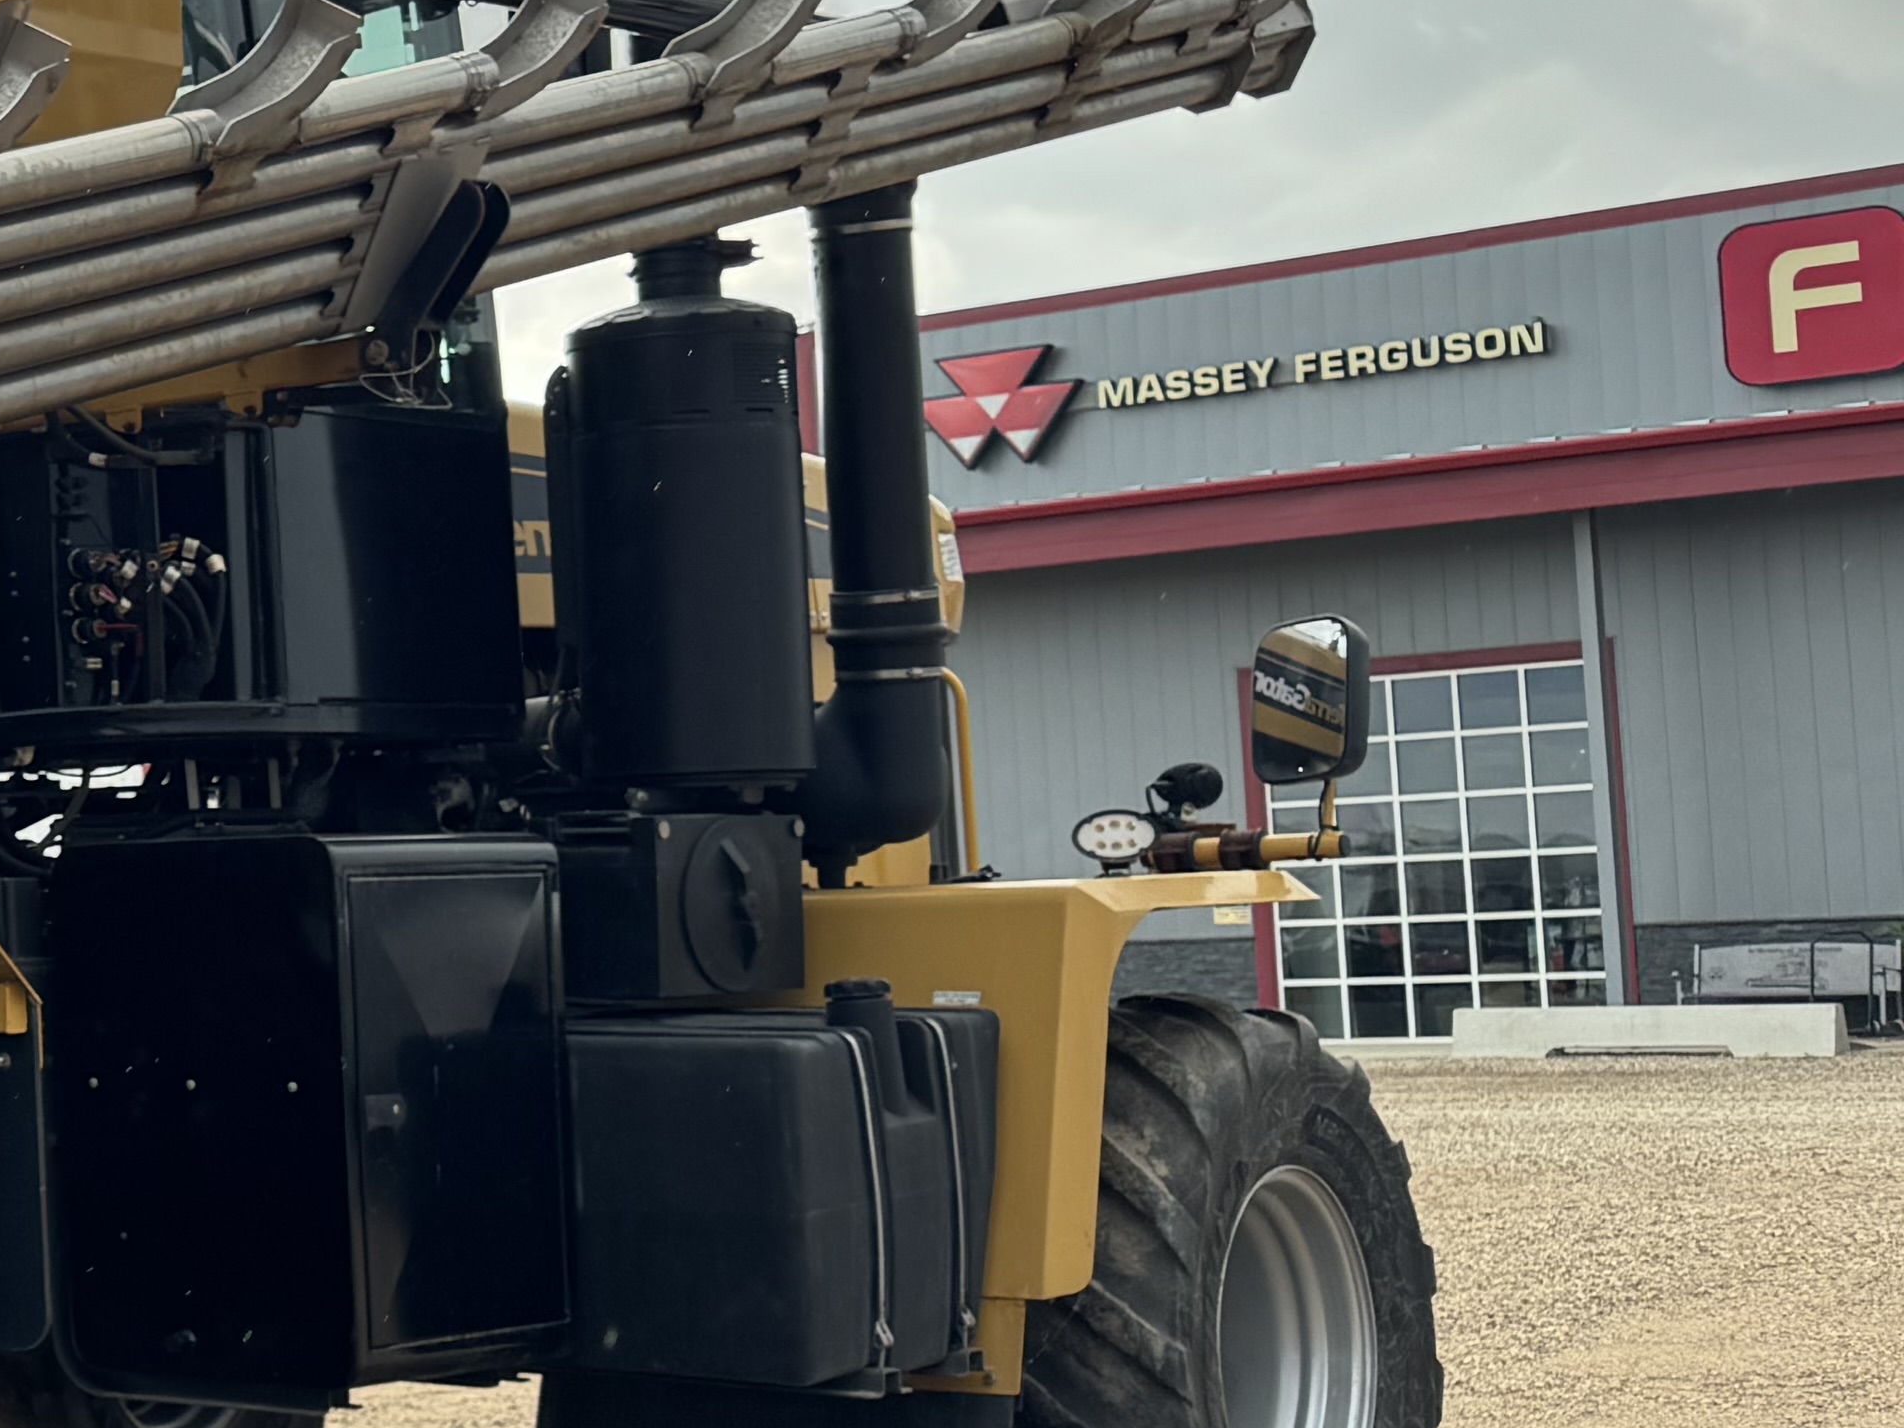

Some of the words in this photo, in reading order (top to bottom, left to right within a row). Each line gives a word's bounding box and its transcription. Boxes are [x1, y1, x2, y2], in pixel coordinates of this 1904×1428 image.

[1769, 240, 1863, 353] F
[1097, 357, 1274, 410] MASSEY
[1294, 321, 1545, 384] FERGUSON
